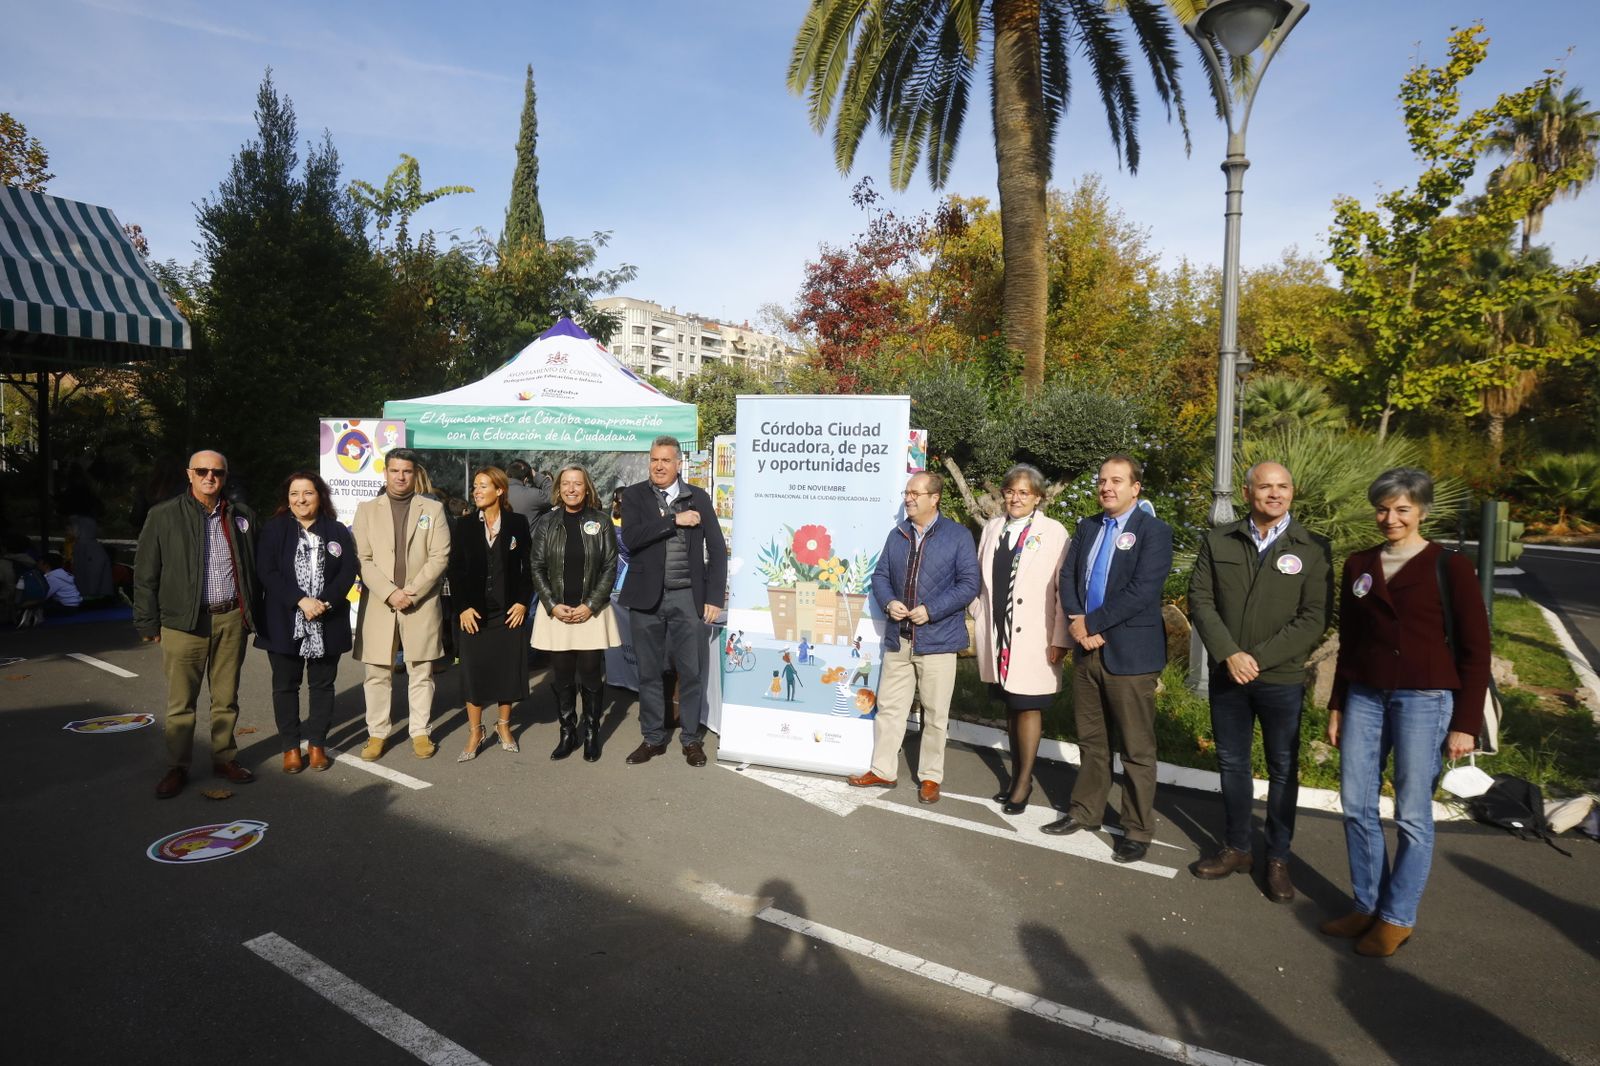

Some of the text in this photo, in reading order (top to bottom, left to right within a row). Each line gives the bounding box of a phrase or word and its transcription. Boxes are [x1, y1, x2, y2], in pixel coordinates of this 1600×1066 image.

[419, 410, 664, 428] El Ayuntamiento de Córdoba comprometido
[447, 427, 637, 442] con la Educación de la Ciudadanía
[760, 421, 881, 437] Córdoba Ciudad
[751, 438, 889, 458] Educadora, de paz
[758, 457, 880, 474] y oportunidades
[351, 480, 382, 488] QUIERES
[807, 484, 846, 492] NOVIEMBRE
